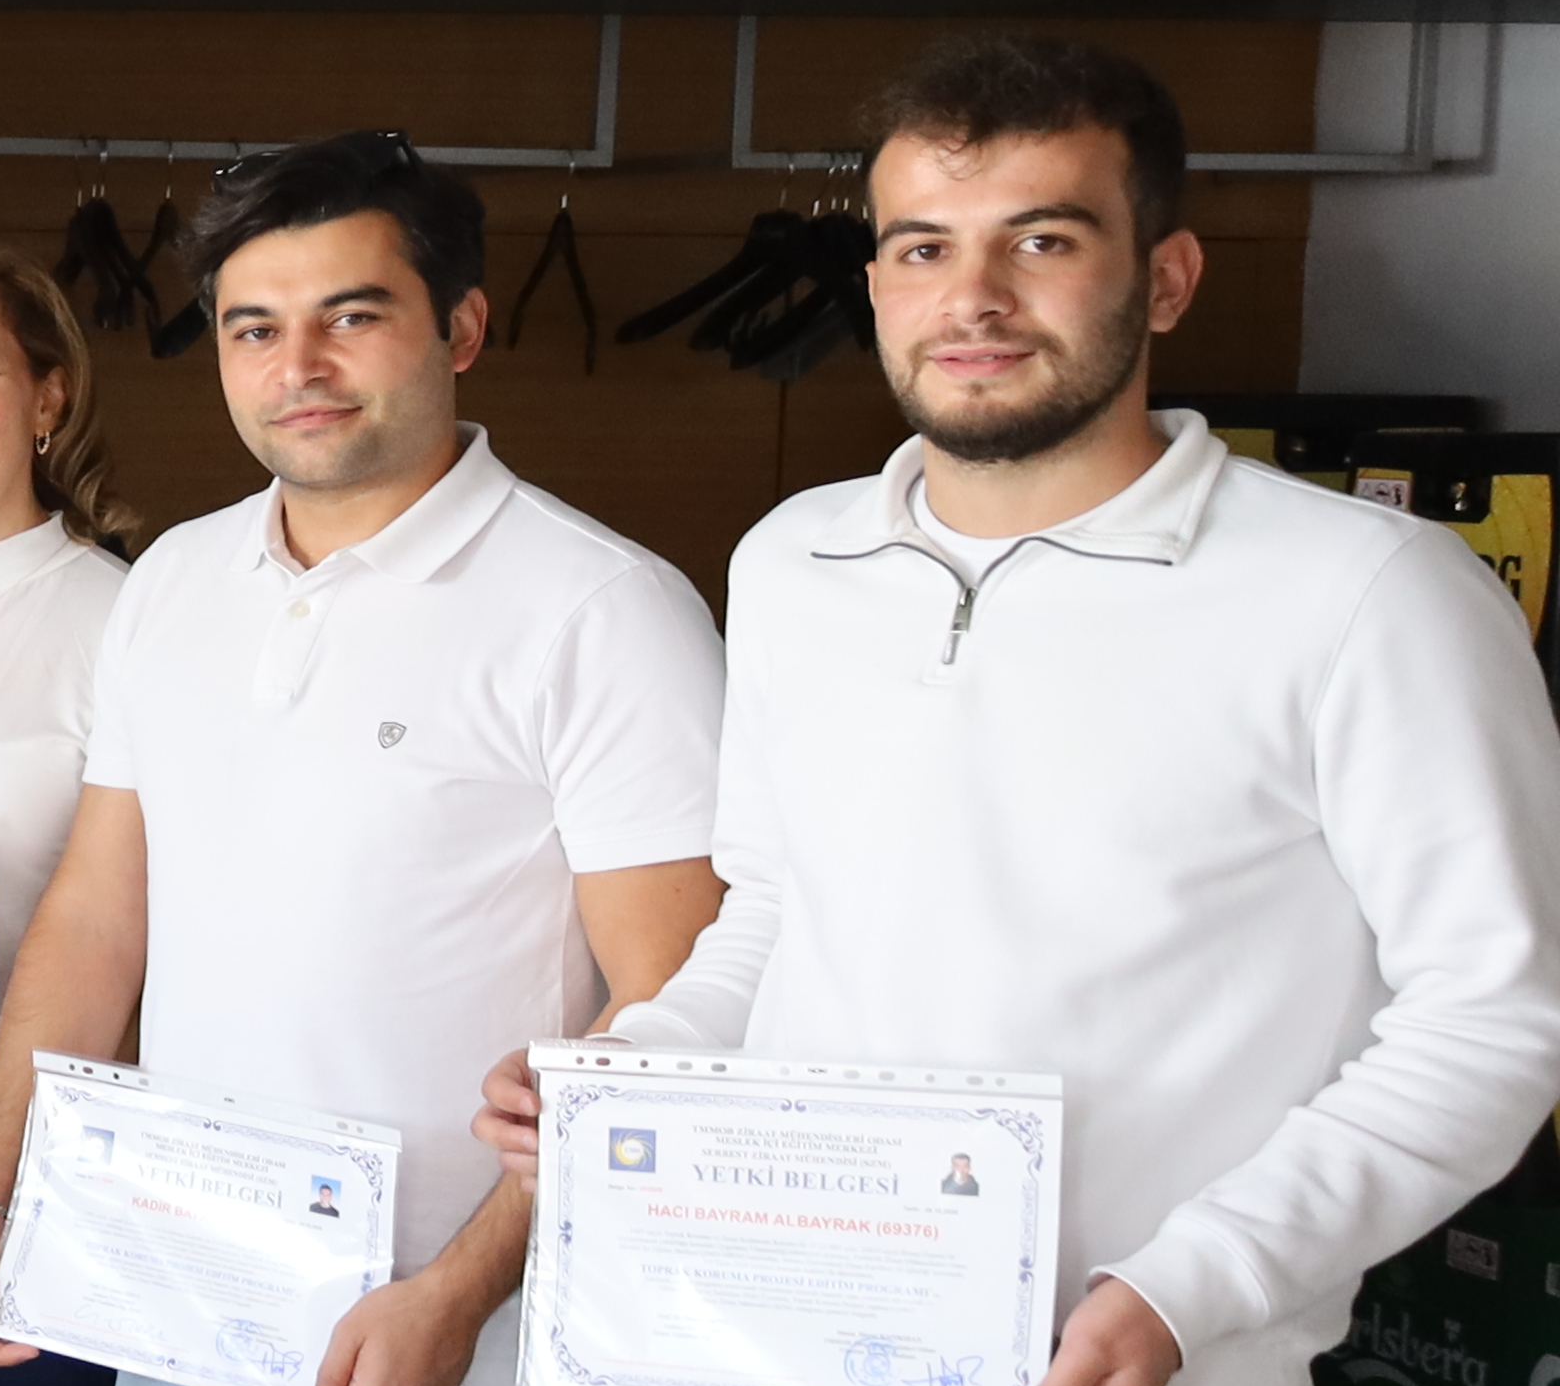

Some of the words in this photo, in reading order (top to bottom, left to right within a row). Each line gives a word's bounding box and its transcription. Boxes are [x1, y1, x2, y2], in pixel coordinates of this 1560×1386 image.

[136, 1163, 196, 1190] YETKİ
[201, 1176, 284, 1210] BELGESİ
[691, 1163, 775, 1188] YETKİ
[784, 1169, 899, 1196] BELGESİ
[130, 1195, 171, 1216] KADİR
[647, 1203, 690, 1221] HACI
[694, 1205, 768, 1226] BAYRAM
[773, 1213, 871, 1235] ALBAYRAK
[876, 1220, 939, 1241] (69376)
